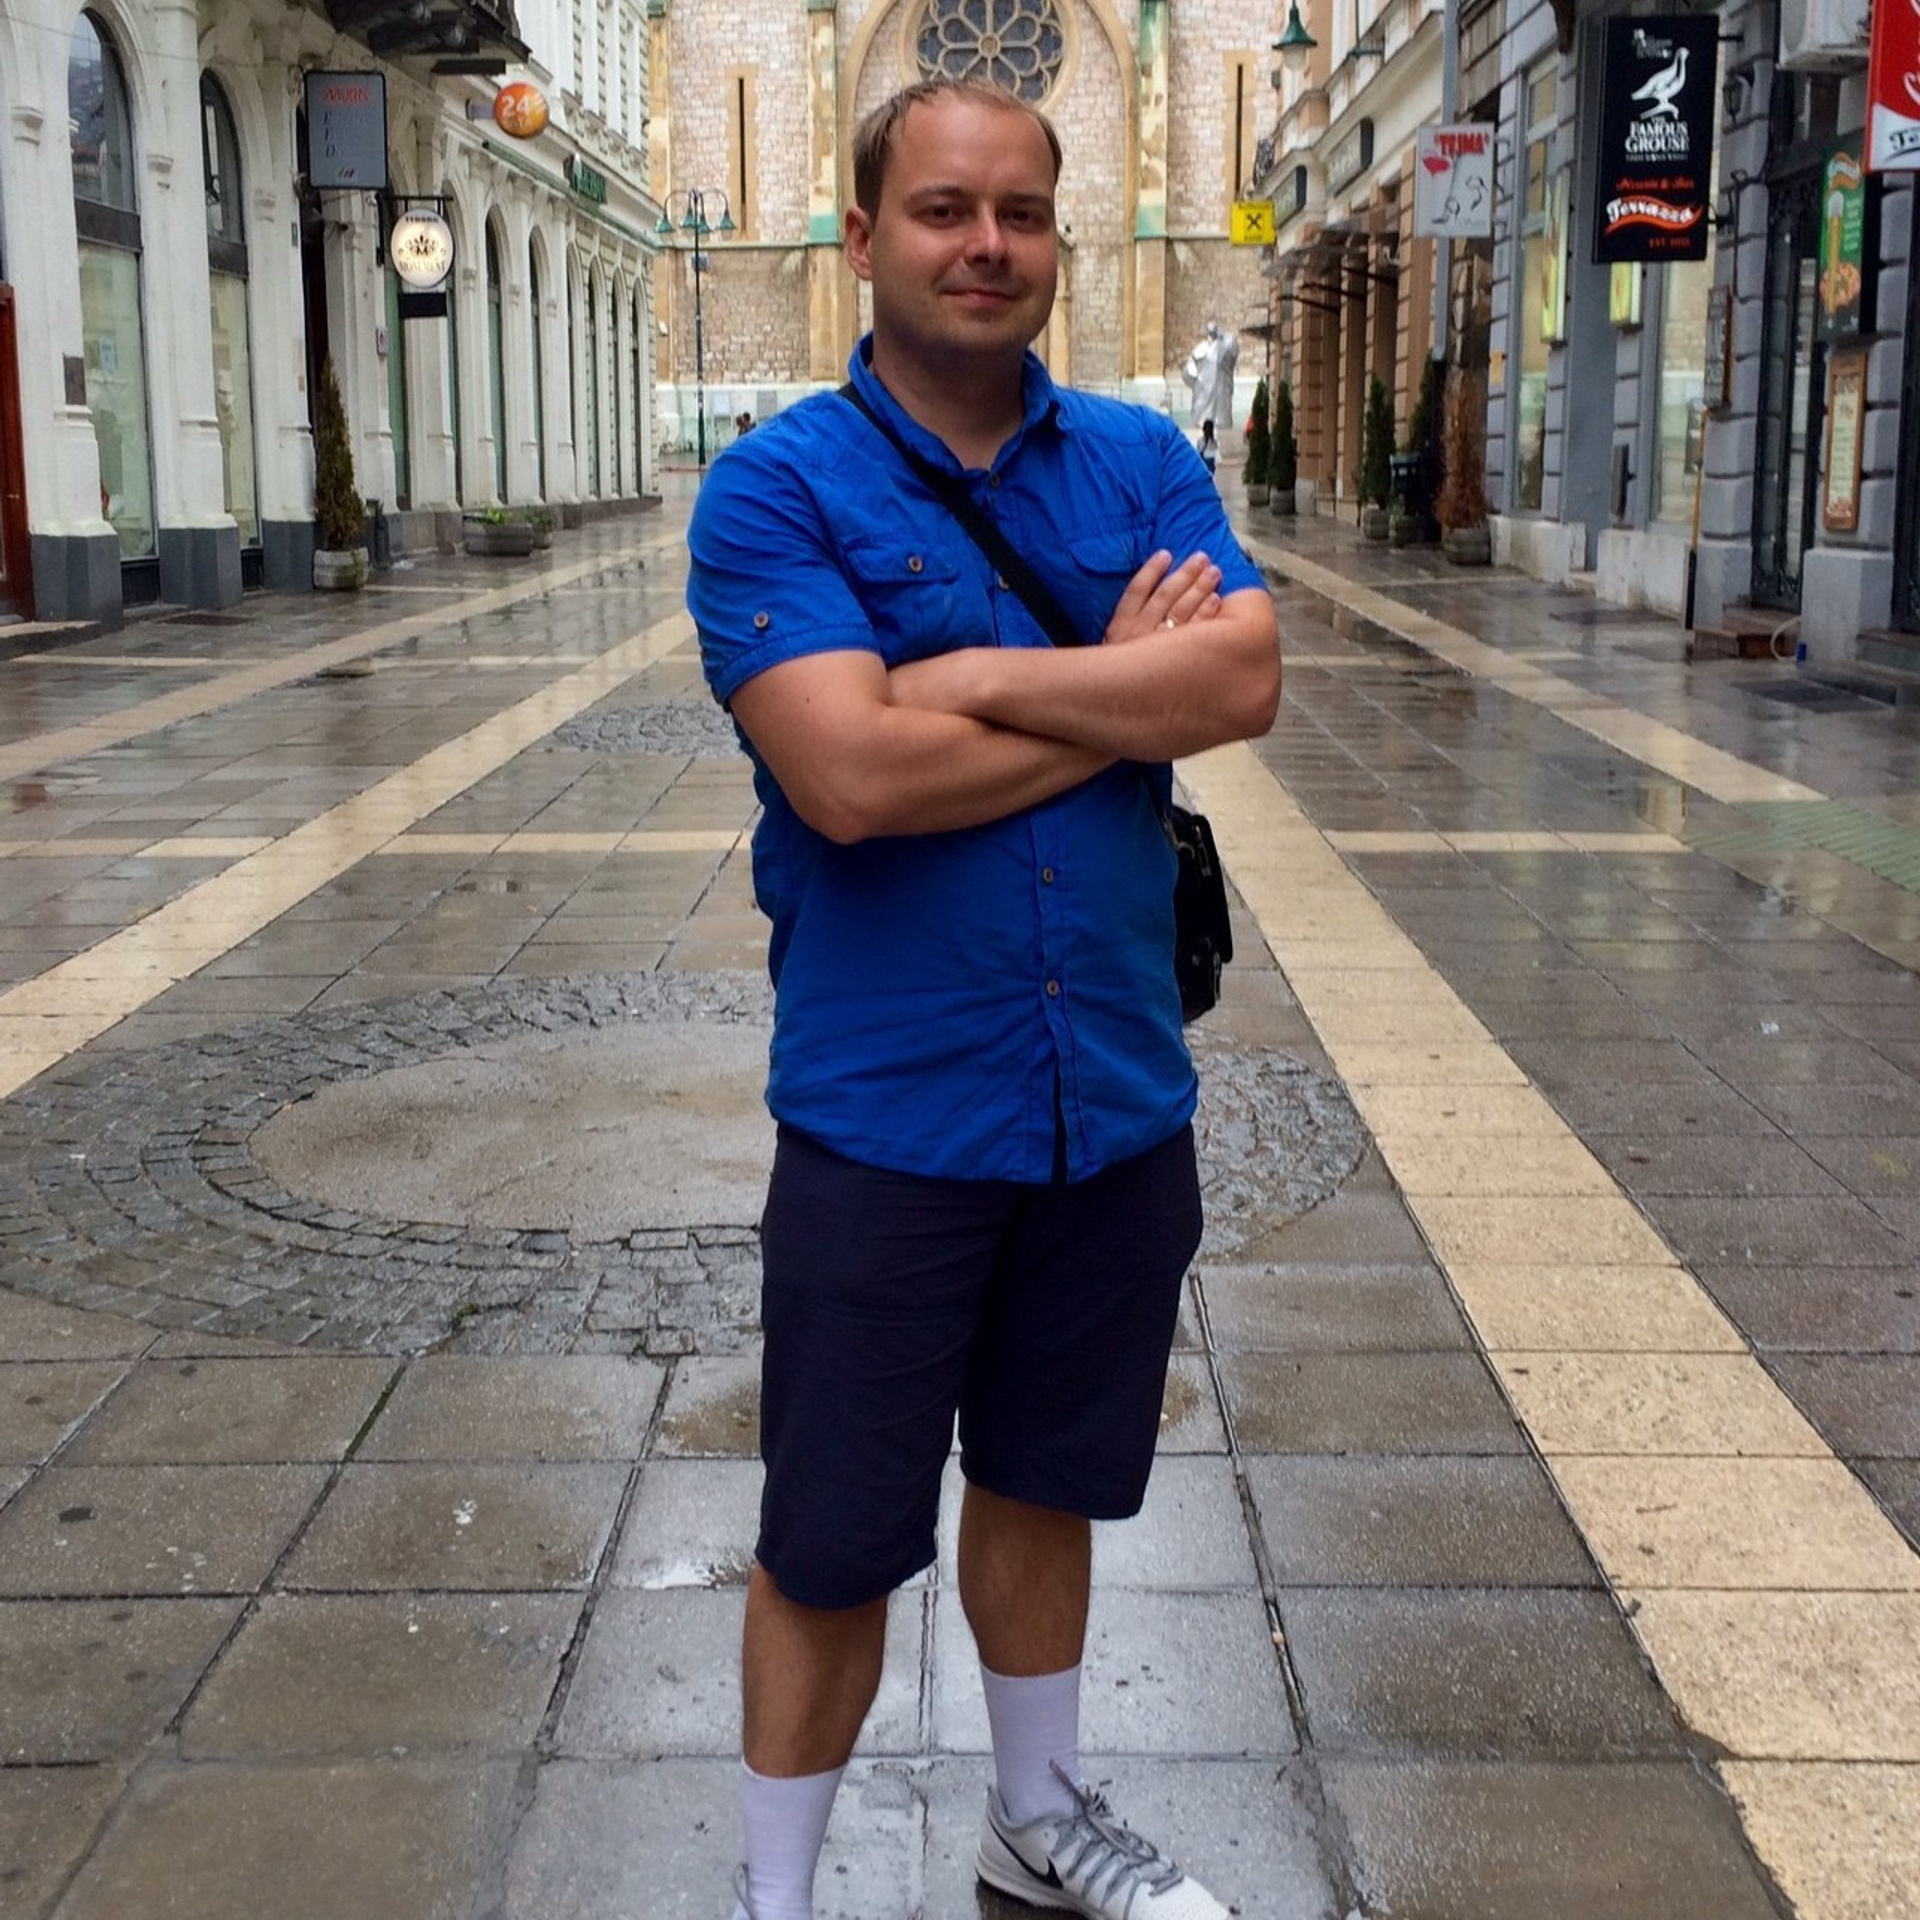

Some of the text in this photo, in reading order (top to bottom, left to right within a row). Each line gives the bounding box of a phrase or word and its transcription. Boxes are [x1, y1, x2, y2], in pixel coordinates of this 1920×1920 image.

[501, 94, 531, 116] 24
[1630, 121, 1689, 137] FAMOUS
[1624, 136, 1690, 153] GROUSE
